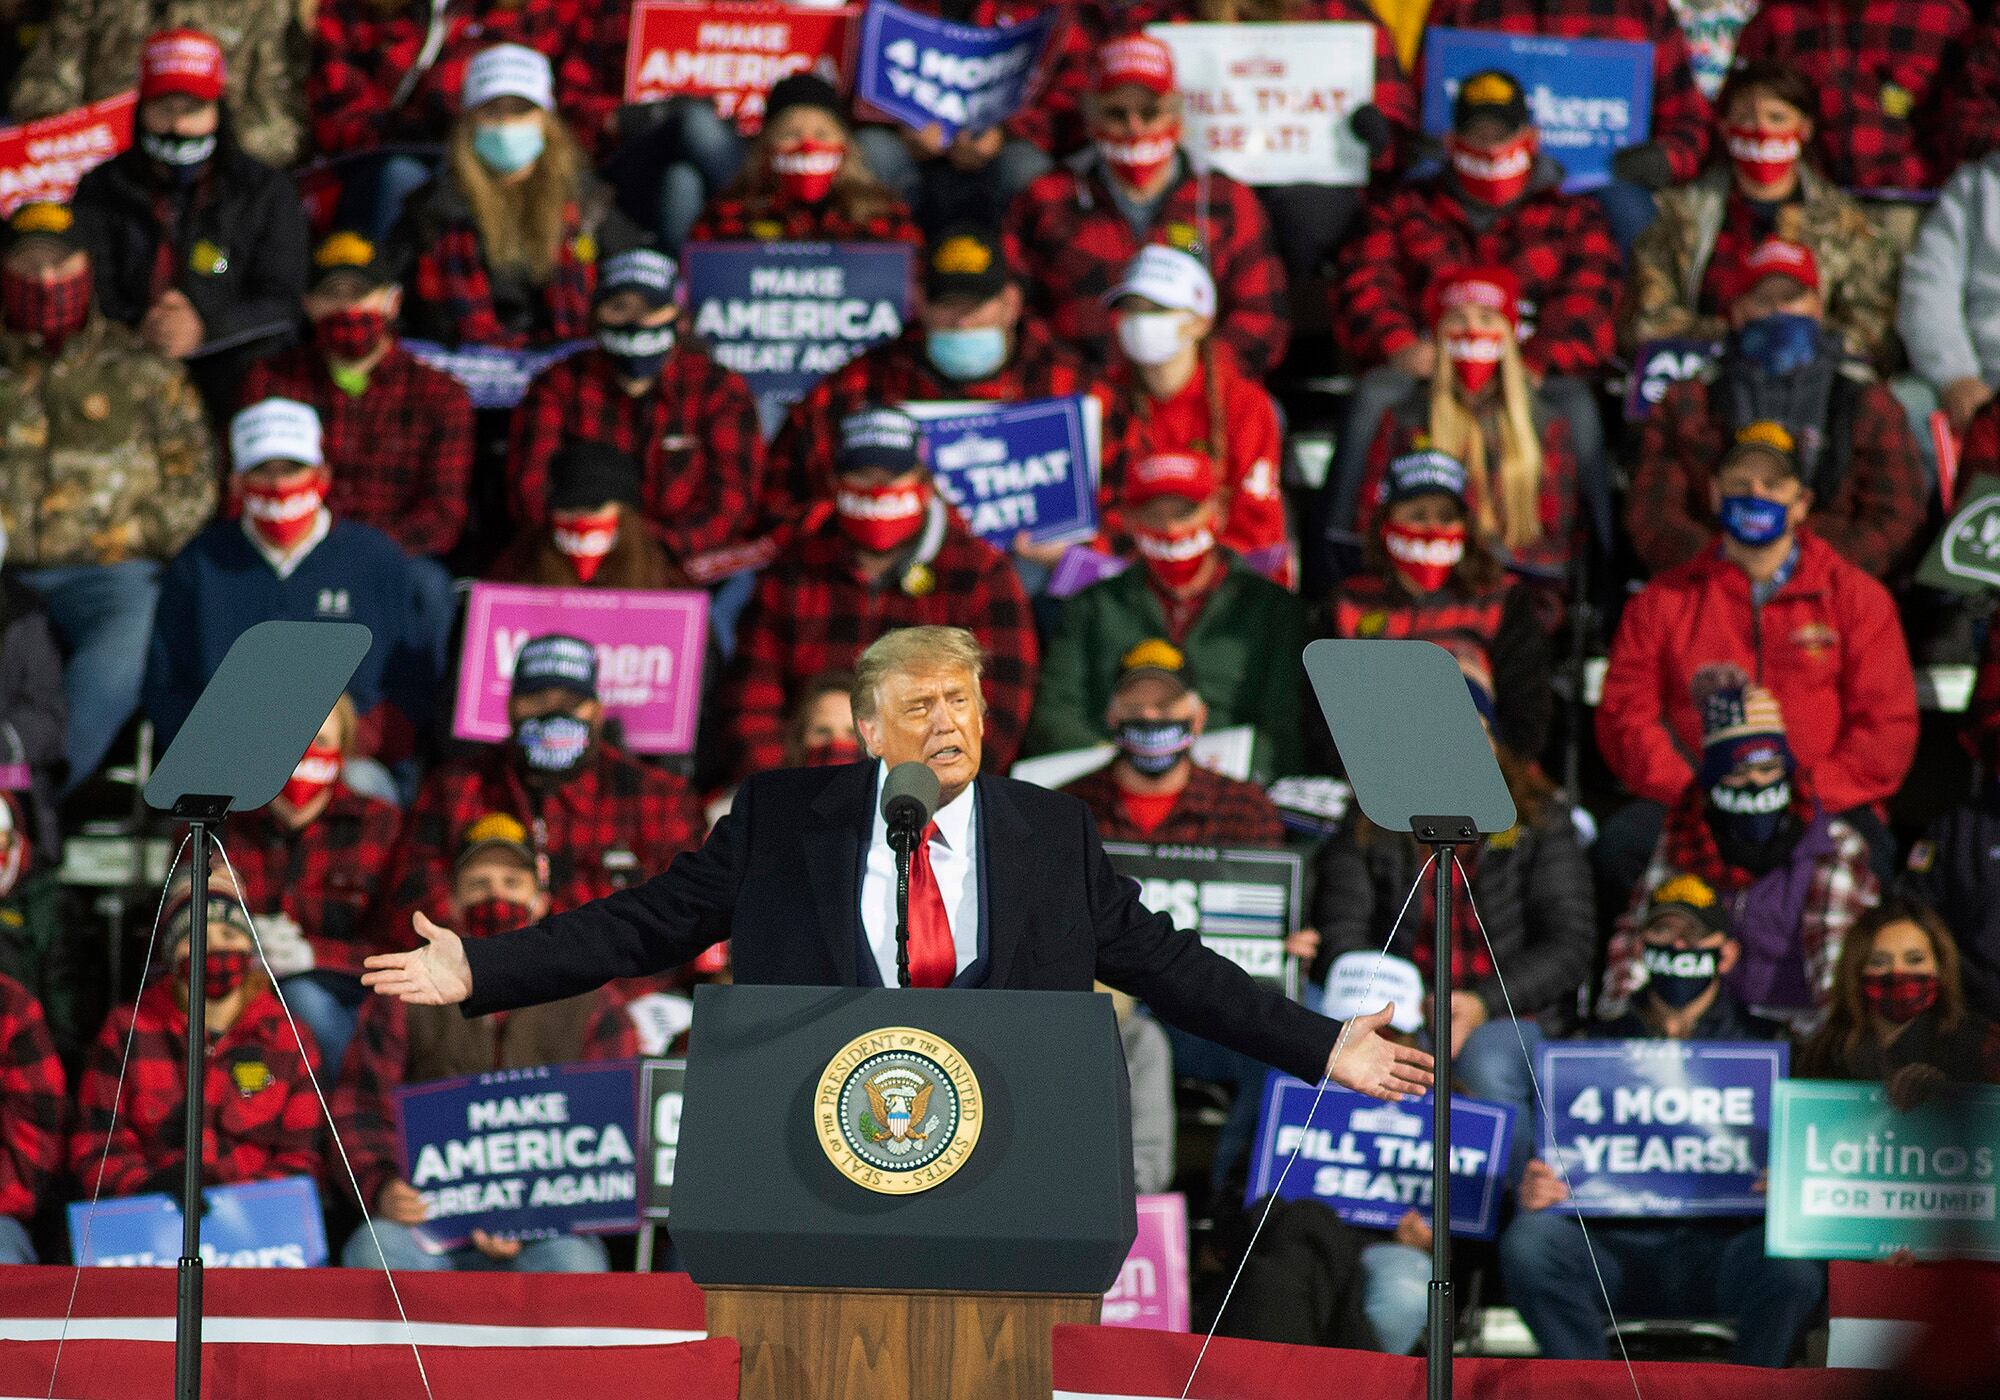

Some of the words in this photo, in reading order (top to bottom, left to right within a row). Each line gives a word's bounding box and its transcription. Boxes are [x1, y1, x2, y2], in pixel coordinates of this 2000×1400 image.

[698, 23, 788, 49] MAKE
[885, 40, 917, 69] 4
[1183, 88, 1239, 114] ILL
[1205, 127, 1308, 152] SET!
[751, 267, 843, 297] MAKE
[694, 300, 901, 340] AMERICA
[712, 343, 795, 374] REAT
[965, 449, 1071, 500] THAT
[493, 627, 674, 687] Wen
[900, 1036, 916, 1046] OF
[919, 1039, 940, 1055] THE
[820, 1034, 896, 1105] PRESIDENT
[943, 1054, 977, 1122] UNITED
[467, 1091, 570, 1131] MAKE
[822, 1112, 835, 1135] THE
[1568, 1086, 1605, 1125] 4
[1613, 1087, 1755, 1126] MORE
[412, 1123, 636, 1186] AMERICA
[829, 1138, 842, 1153] OF
[912, 1137, 970, 1186] STATES
[1276, 1124, 1366, 1165] FILL
[1574, 1134, 1753, 1175] YEARS!
[1805, 1123, 1995, 1179] Latinos
[840, 1150, 883, 1185] SEAL
[420, 1177, 527, 1221] GREAT
[529, 1169, 637, 1208] AGAIN
[1813, 1188, 1870, 1209] FOR
[1881, 1190, 1987, 1211] TRUMP
